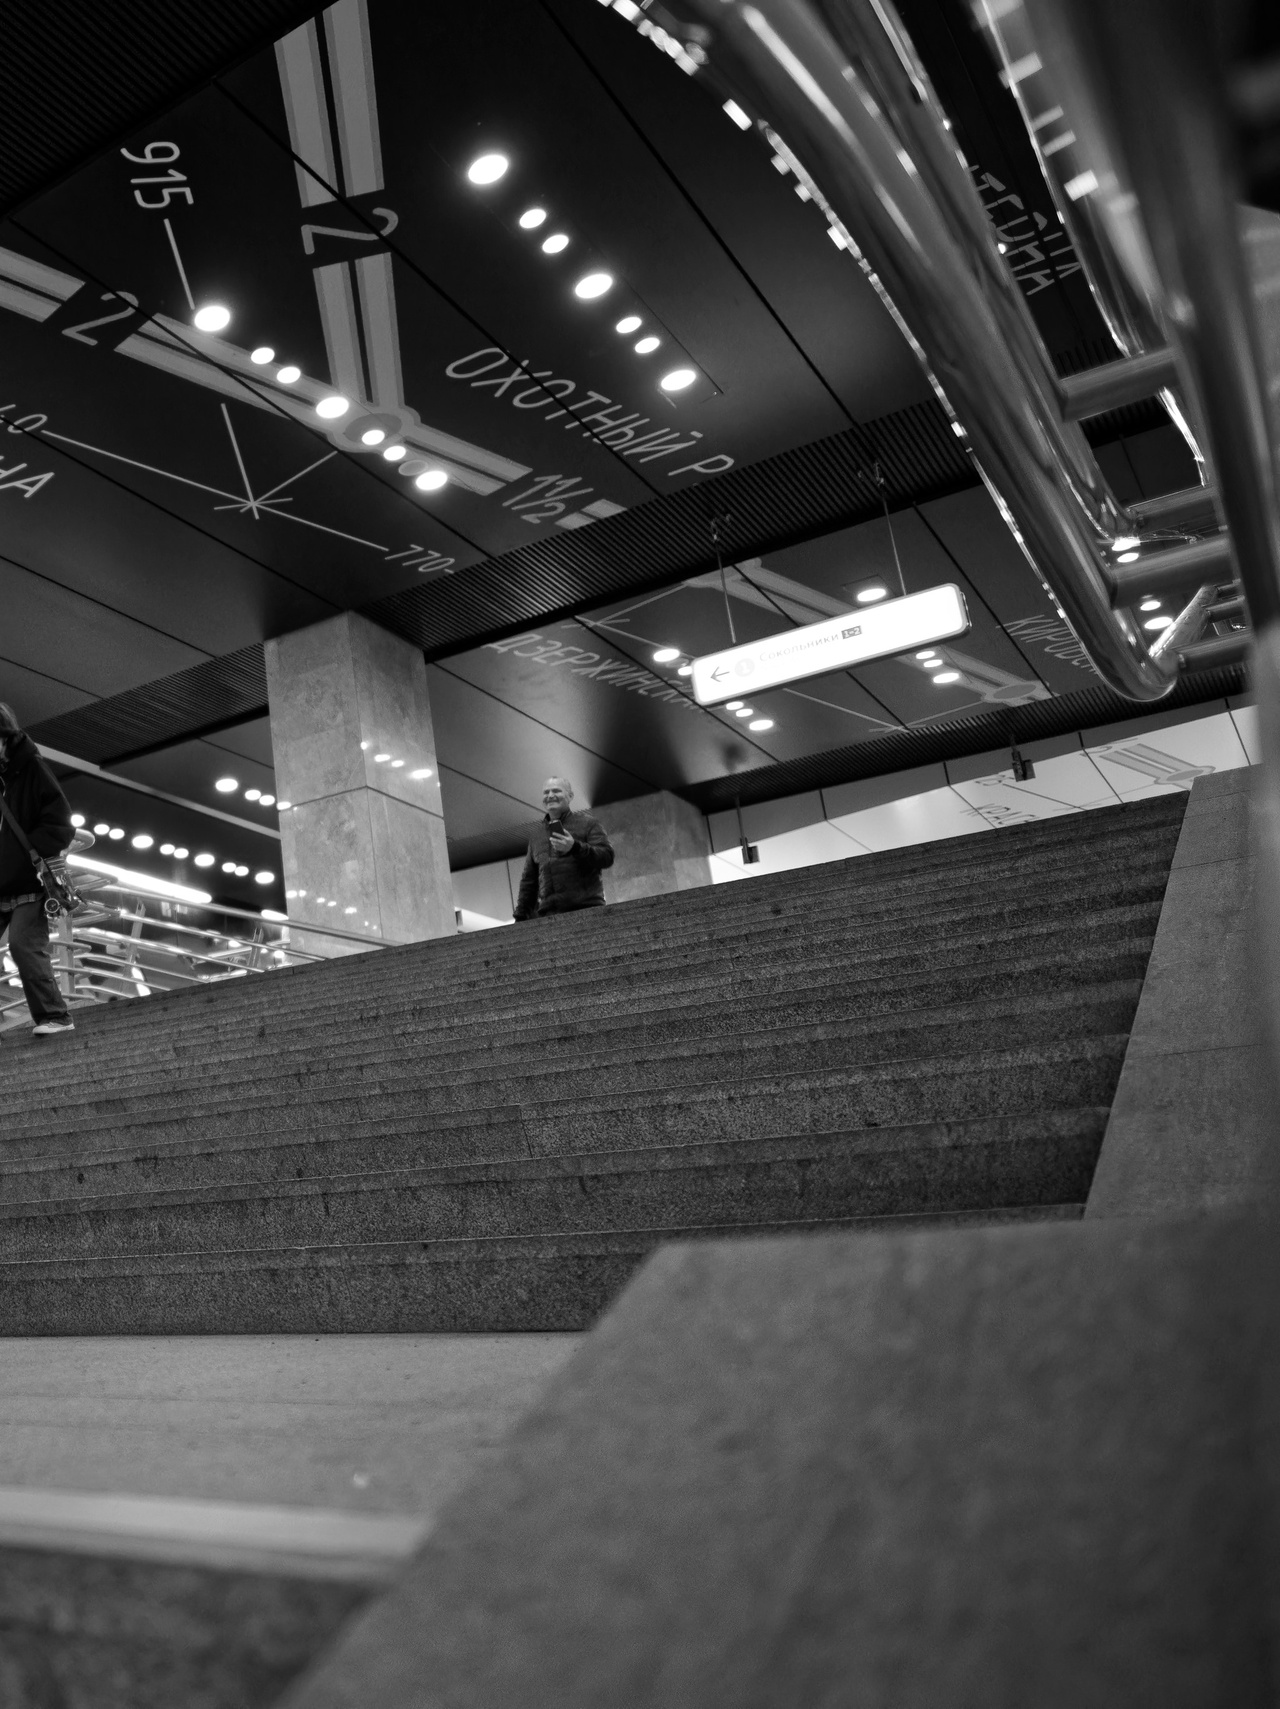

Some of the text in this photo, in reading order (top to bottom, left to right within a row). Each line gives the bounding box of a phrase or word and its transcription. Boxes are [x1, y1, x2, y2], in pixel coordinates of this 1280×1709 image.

[120, 141, 194, 209] 915
[301, 207, 399, 255] 2
[61, 290, 139, 346] 2
[445, 347, 704, 464] ОХОТНЫЙ
[759, 633, 839, 662] Сокольники
